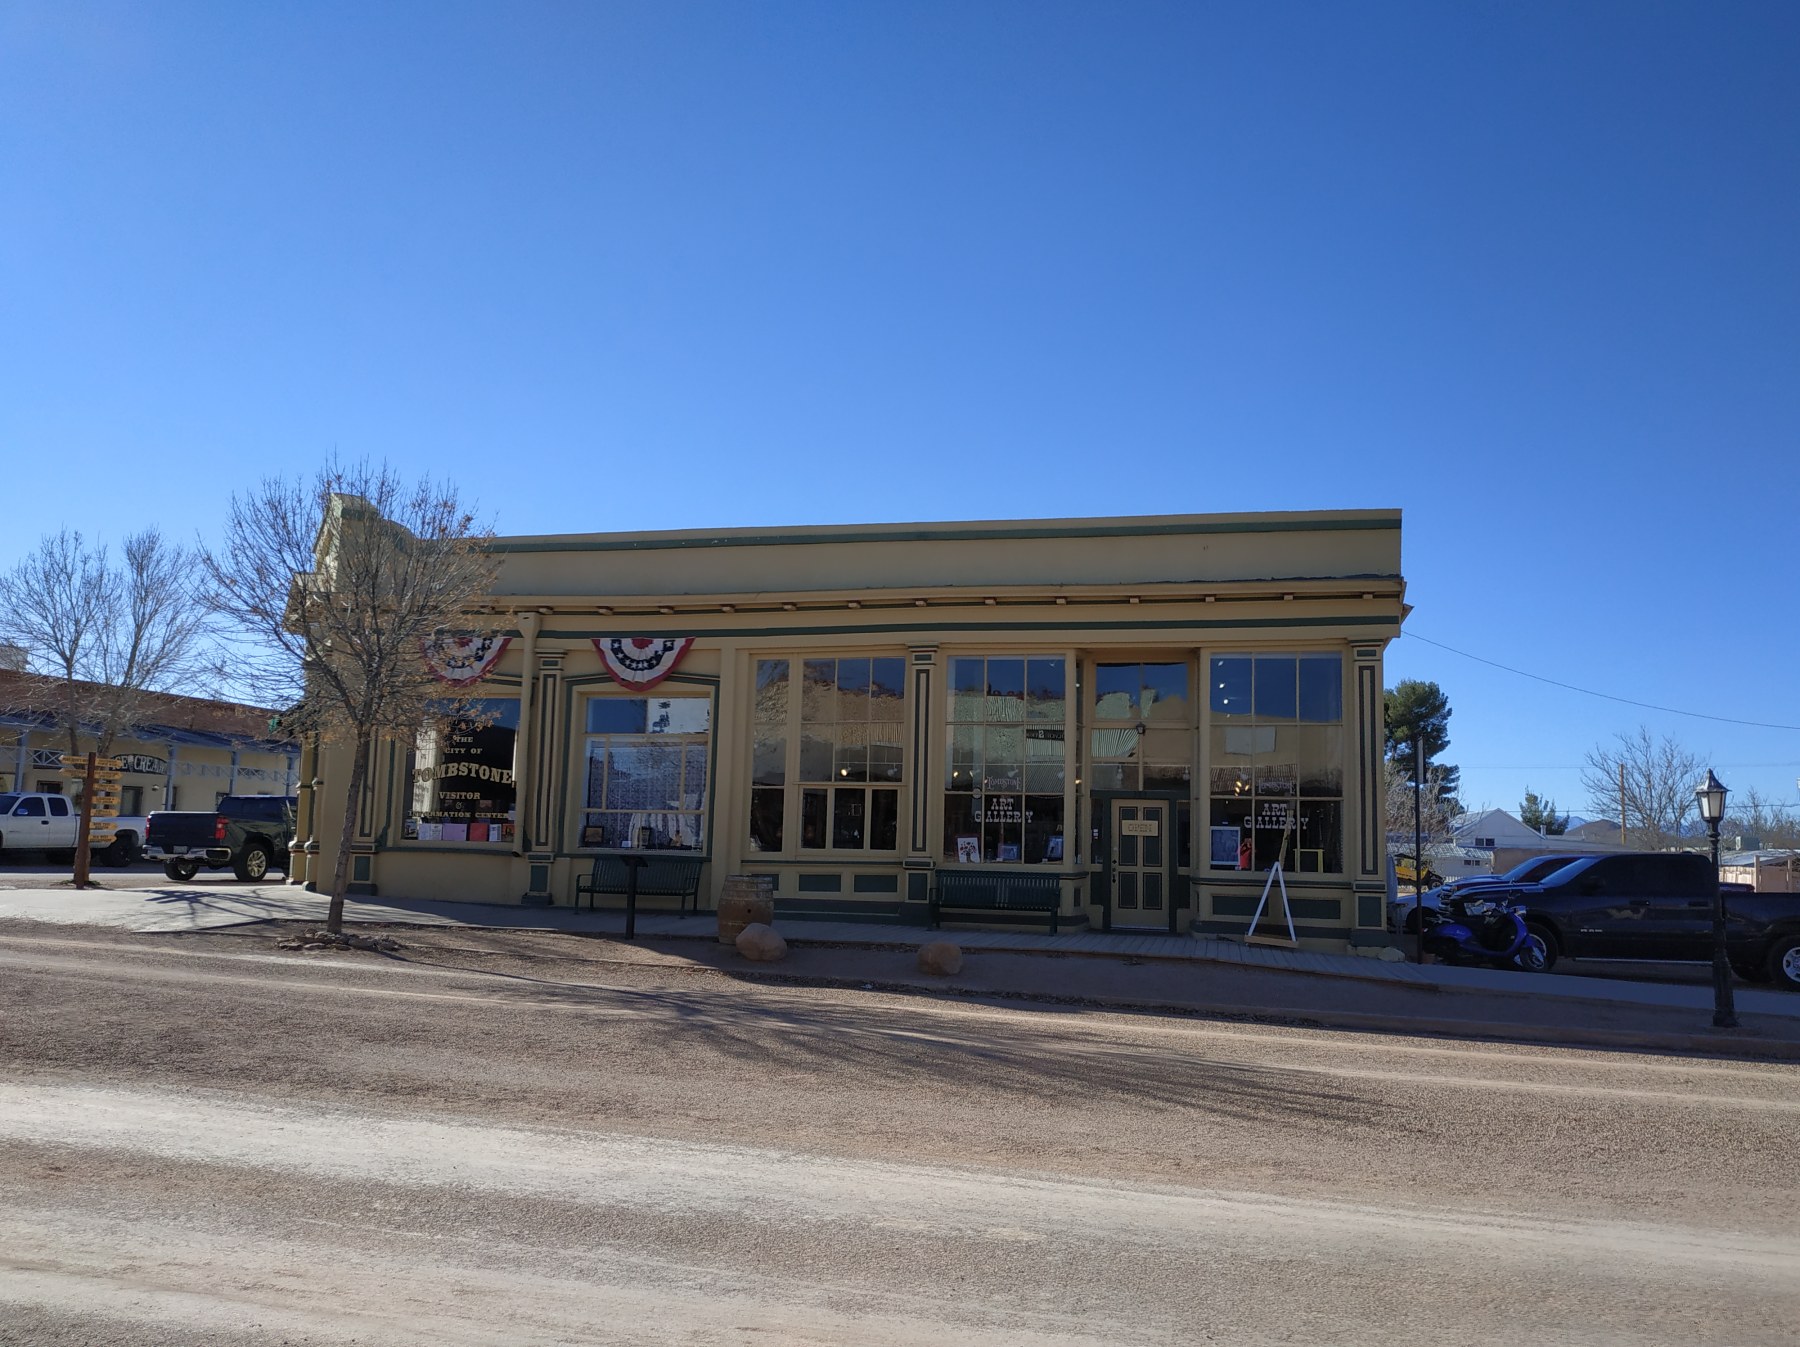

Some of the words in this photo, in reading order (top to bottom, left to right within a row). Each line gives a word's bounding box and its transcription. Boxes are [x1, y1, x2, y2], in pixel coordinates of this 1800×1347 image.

[439, 791, 481, 800] VISITOR
[991, 798, 1015, 810] ART
[1262, 803, 1287, 816] ART
[974, 811, 1034, 823] GALLERY
[1243, 816, 1309, 830] GALLERY
